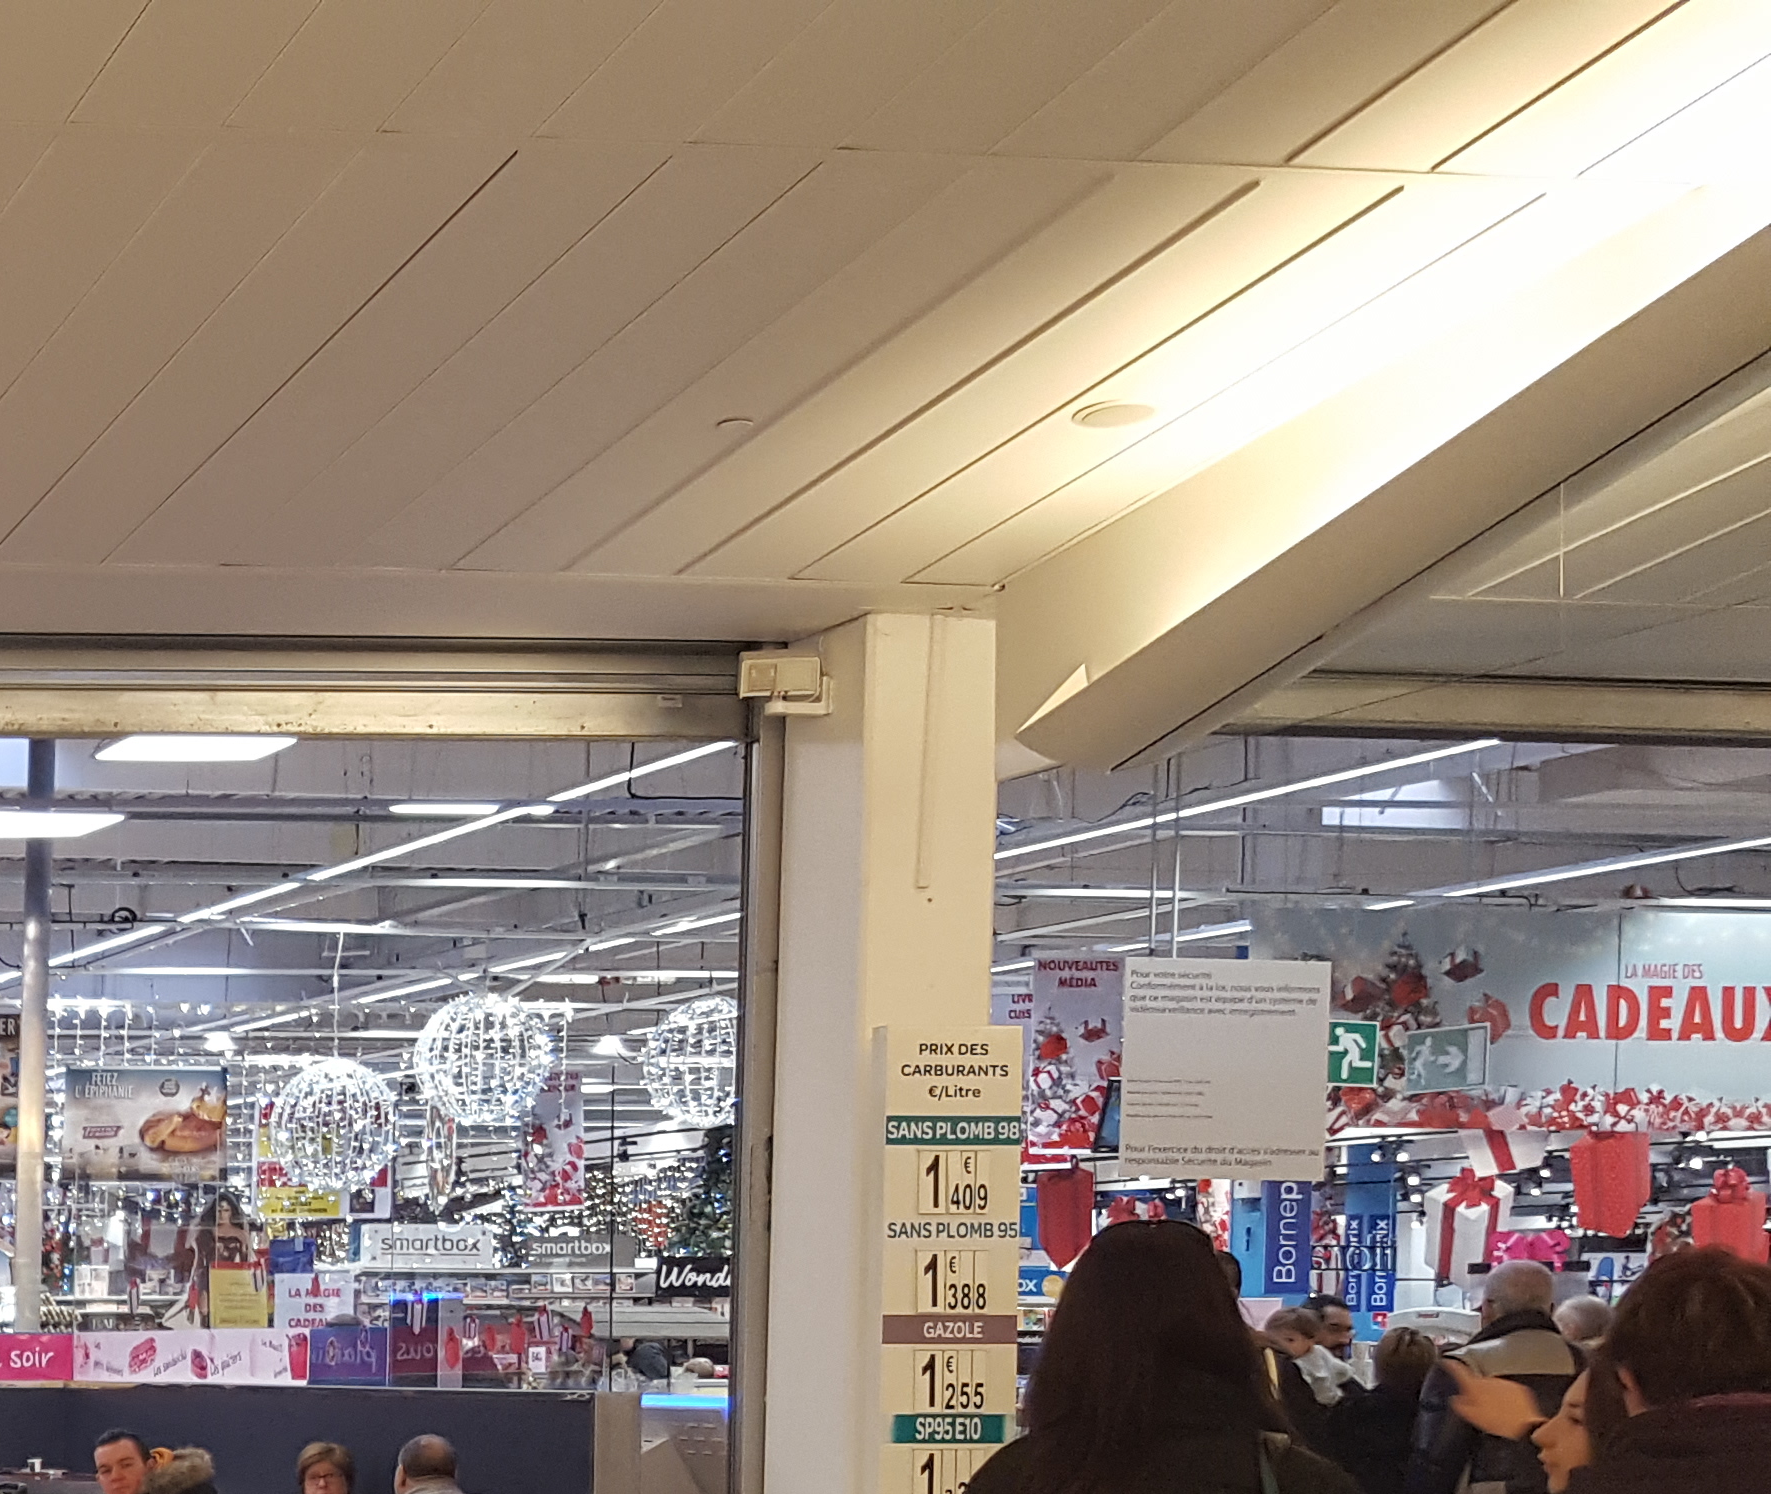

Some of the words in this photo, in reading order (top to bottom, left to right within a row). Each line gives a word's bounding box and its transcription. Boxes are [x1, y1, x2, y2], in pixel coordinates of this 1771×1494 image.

[1130, 969, 1151, 978] Pour
[1625, 963, 1638, 979] LA
[1642, 963, 1679, 979] MAGIE
[1682, 963, 1703, 979] DES
[919, 1043, 955, 1056] PRIX
[958, 1043, 989, 1056] DES
[901, 1064, 1009, 1077] CARBURANTS
[928, 1085, 981, 1101] €/Litre
[887, 1121, 933, 1139] SANS
[936, 1121, 995, 1139] PLOMB
[998, 1121, 1019, 1139] 98
[925, 1154, 940, 1209] 1
[887, 1222, 932, 1239] SANS
[936, 1222, 994, 1239] PLOMB
[997, 1222, 1018, 1239] 95
[1272, 1181, 1304, 1283] Bornep
[380, 1234, 481, 1254] smartbox
[531, 1240, 611, 1256] smartbox
[659, 1264, 731, 1289] Wond
[923, 1253, 938, 1308] 1
[288, 1287, 302, 1299] LA
[304, 1303, 325, 1313] DES
[288, 1317, 328, 1328] CADEA
[923, 1321, 984, 1338] GAZOLE
[9, 1346, 55, 1368] soir
[921, 1353, 936, 1408] 1
[915, 1417, 952, 1440] SP95
[955, 1417, 982, 1440] E10
